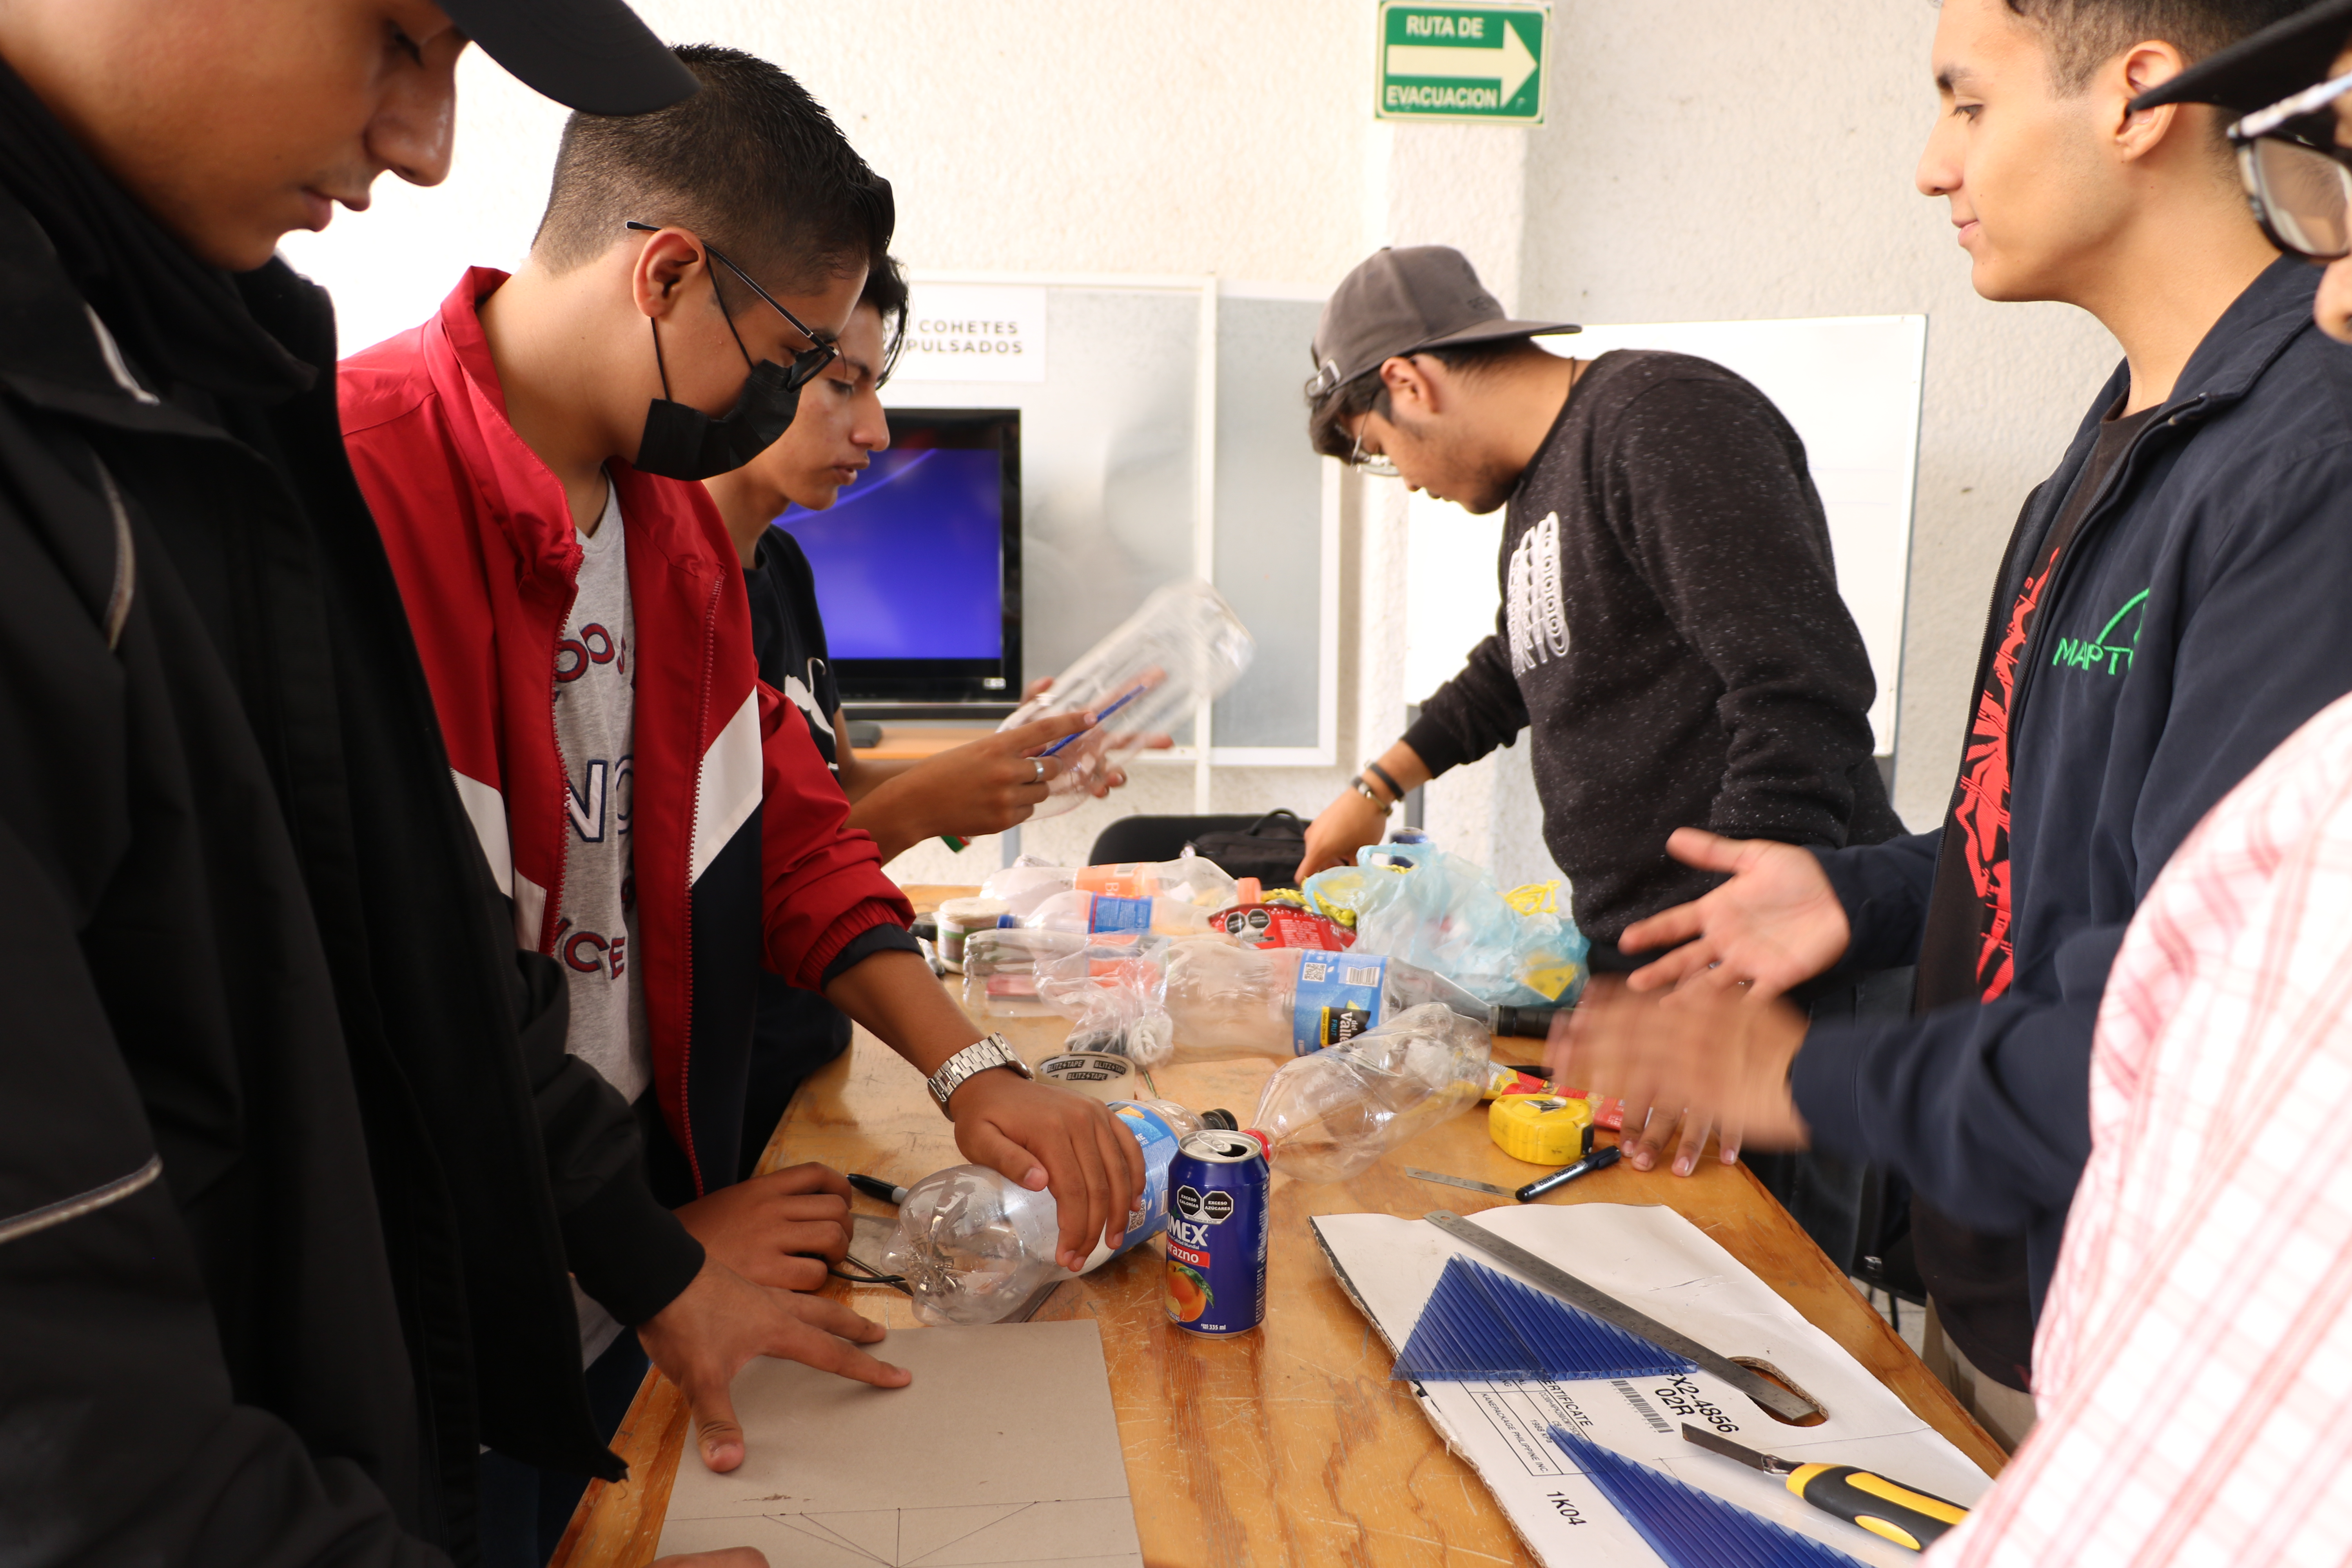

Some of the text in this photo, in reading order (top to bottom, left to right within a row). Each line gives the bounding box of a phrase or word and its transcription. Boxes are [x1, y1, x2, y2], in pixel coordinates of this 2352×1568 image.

[1406, 15, 1484, 38] RUTA DE
[1386, 85, 1497, 109] EVACUACION
[919, 320, 1018, 334] COHETES
[907, 339, 1023, 353] PULSADOS
[1339, 1011, 1353, 1042] Valle
[1048, 1063, 1062, 1071] BLITZ
[1095, 1061, 1125, 1074] BLITZ TAPE
[1539, 1165, 1577, 1186] edding 1880
[1179, 1199, 1199, 1208] CALORÍAS
[1181, 1194, 1197, 1202] EXCESO
[1184, 1241, 1200, 1250] Mundial
[1655, 1388, 1695, 1416] 02R
[1530, 1419, 1545, 1432] 1988
[1481, 1393, 1548, 1473] KANEPACKAGE PHILIPPINE INC.
[1546, 1491, 1587, 1525] 1K04
